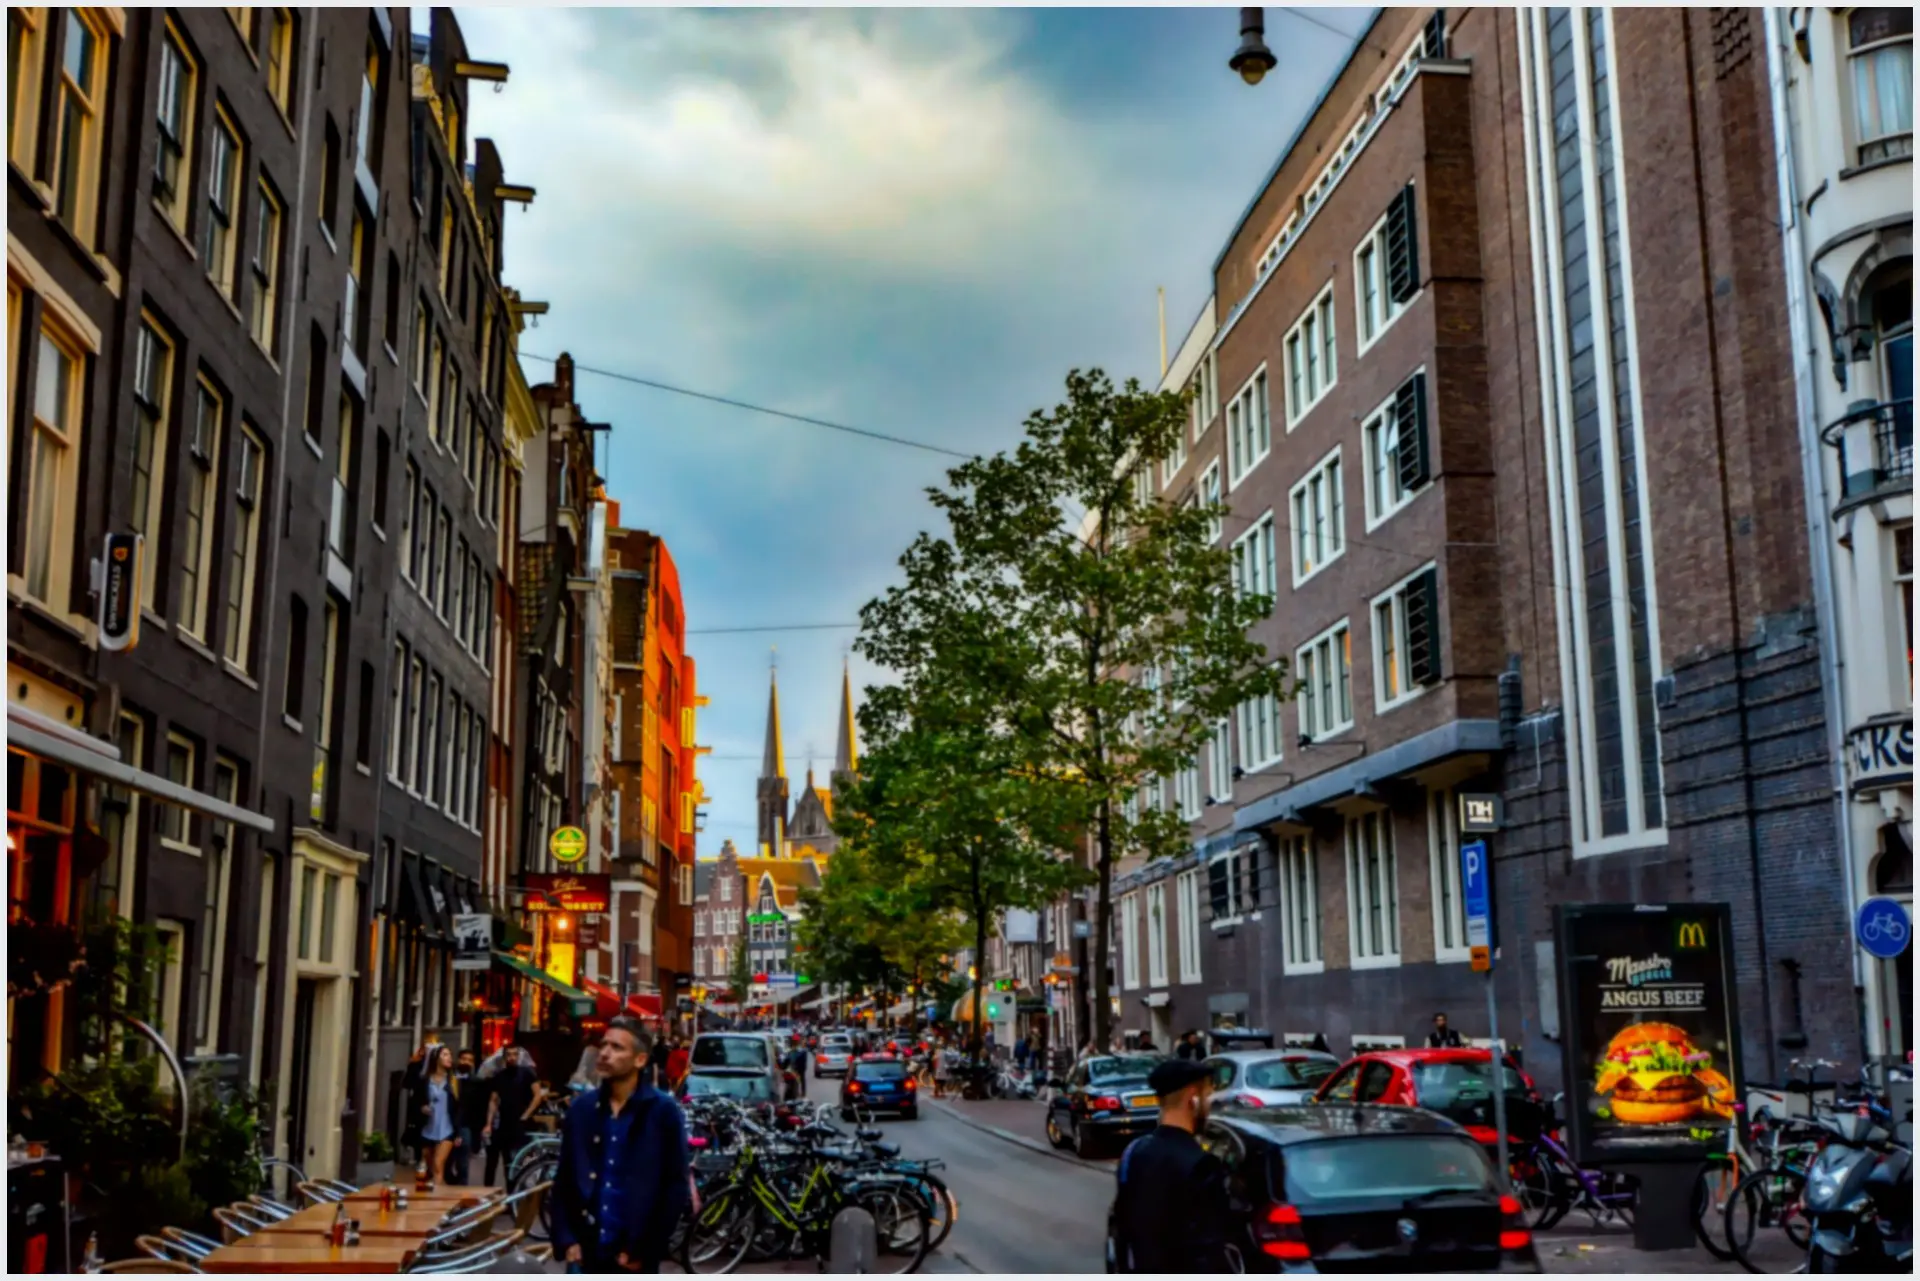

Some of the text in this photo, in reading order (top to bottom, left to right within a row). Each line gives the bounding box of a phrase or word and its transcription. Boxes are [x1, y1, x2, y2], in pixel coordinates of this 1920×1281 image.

[1466, 851, 1479, 888] P
[1605, 953, 1672, 985] Maestro
[1601, 989, 1704, 1007] ANGUS BEEF
